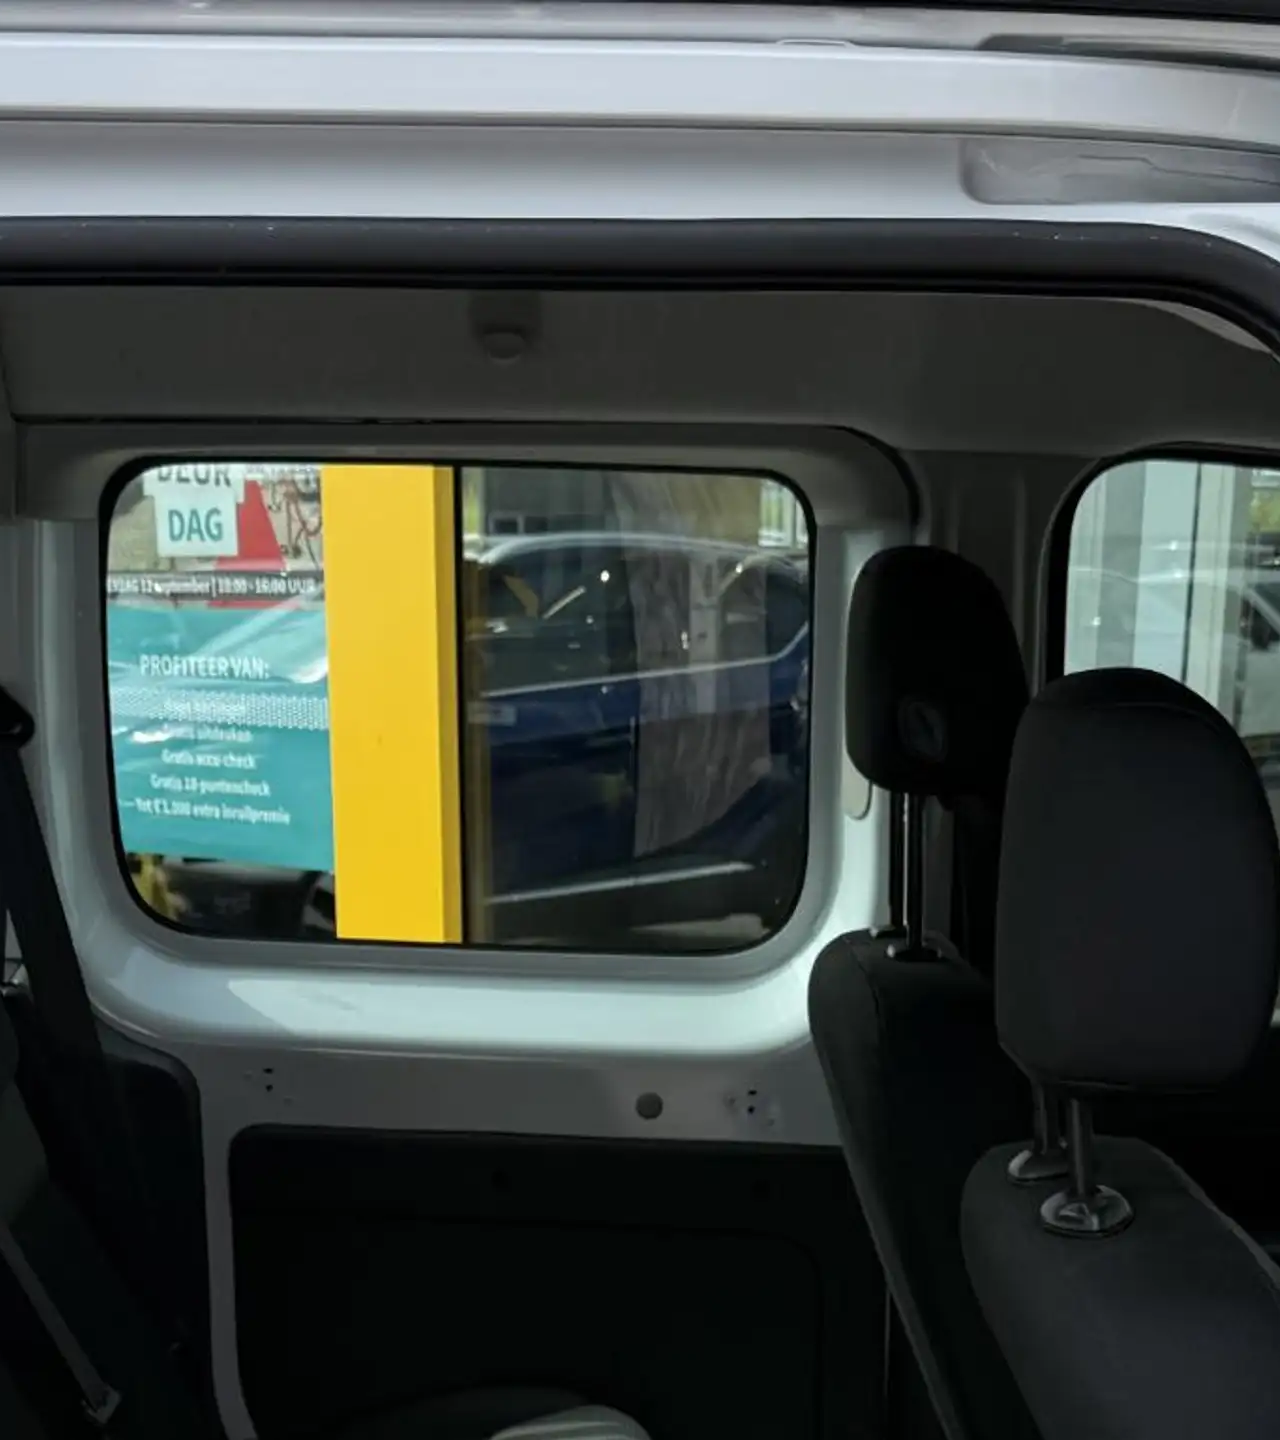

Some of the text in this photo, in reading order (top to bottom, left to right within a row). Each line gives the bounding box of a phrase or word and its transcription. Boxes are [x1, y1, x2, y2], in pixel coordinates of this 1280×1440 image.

[168, 507, 224, 542] DAG
[140, 653, 269, 679] PROFITEER VAN:
